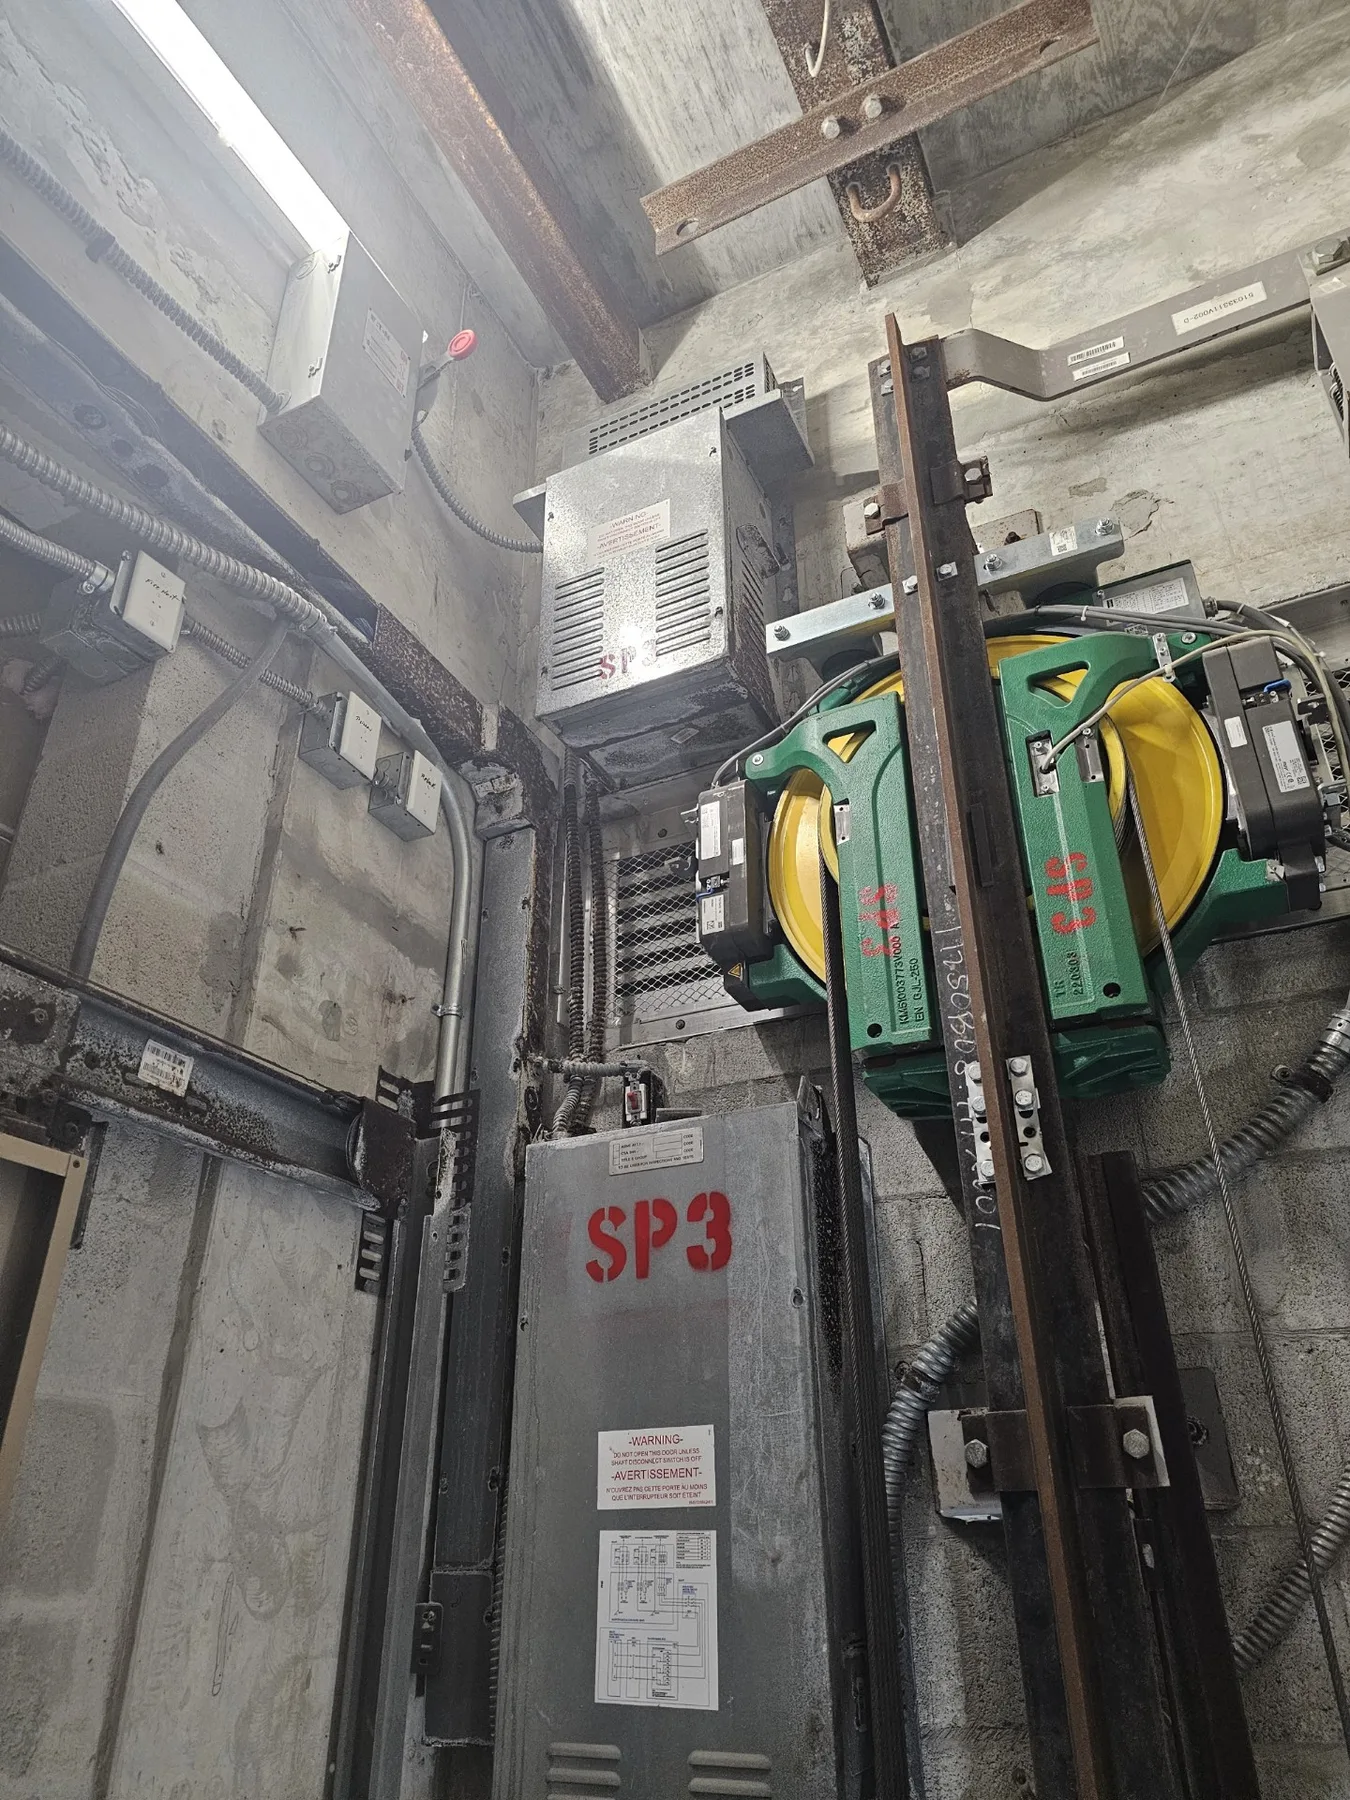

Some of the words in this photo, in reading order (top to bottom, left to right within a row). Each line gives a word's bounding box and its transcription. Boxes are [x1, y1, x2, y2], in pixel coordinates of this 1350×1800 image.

[858, 882, 902, 958] SP3
[1044, 852, 1097, 936] SP3
[891, 935, 909, 1025] KM51003773V000
[909, 957, 924, 1002] GJL-250
[914, 1007, 925, 1023] EN
[585, 1191, 732, 1283] SP3
[628, 1457, 662, 1465] DISCONNECT
[662, 1448, 677, 1456] DOOR
[679, 1447, 700, 1455] UNLESS
